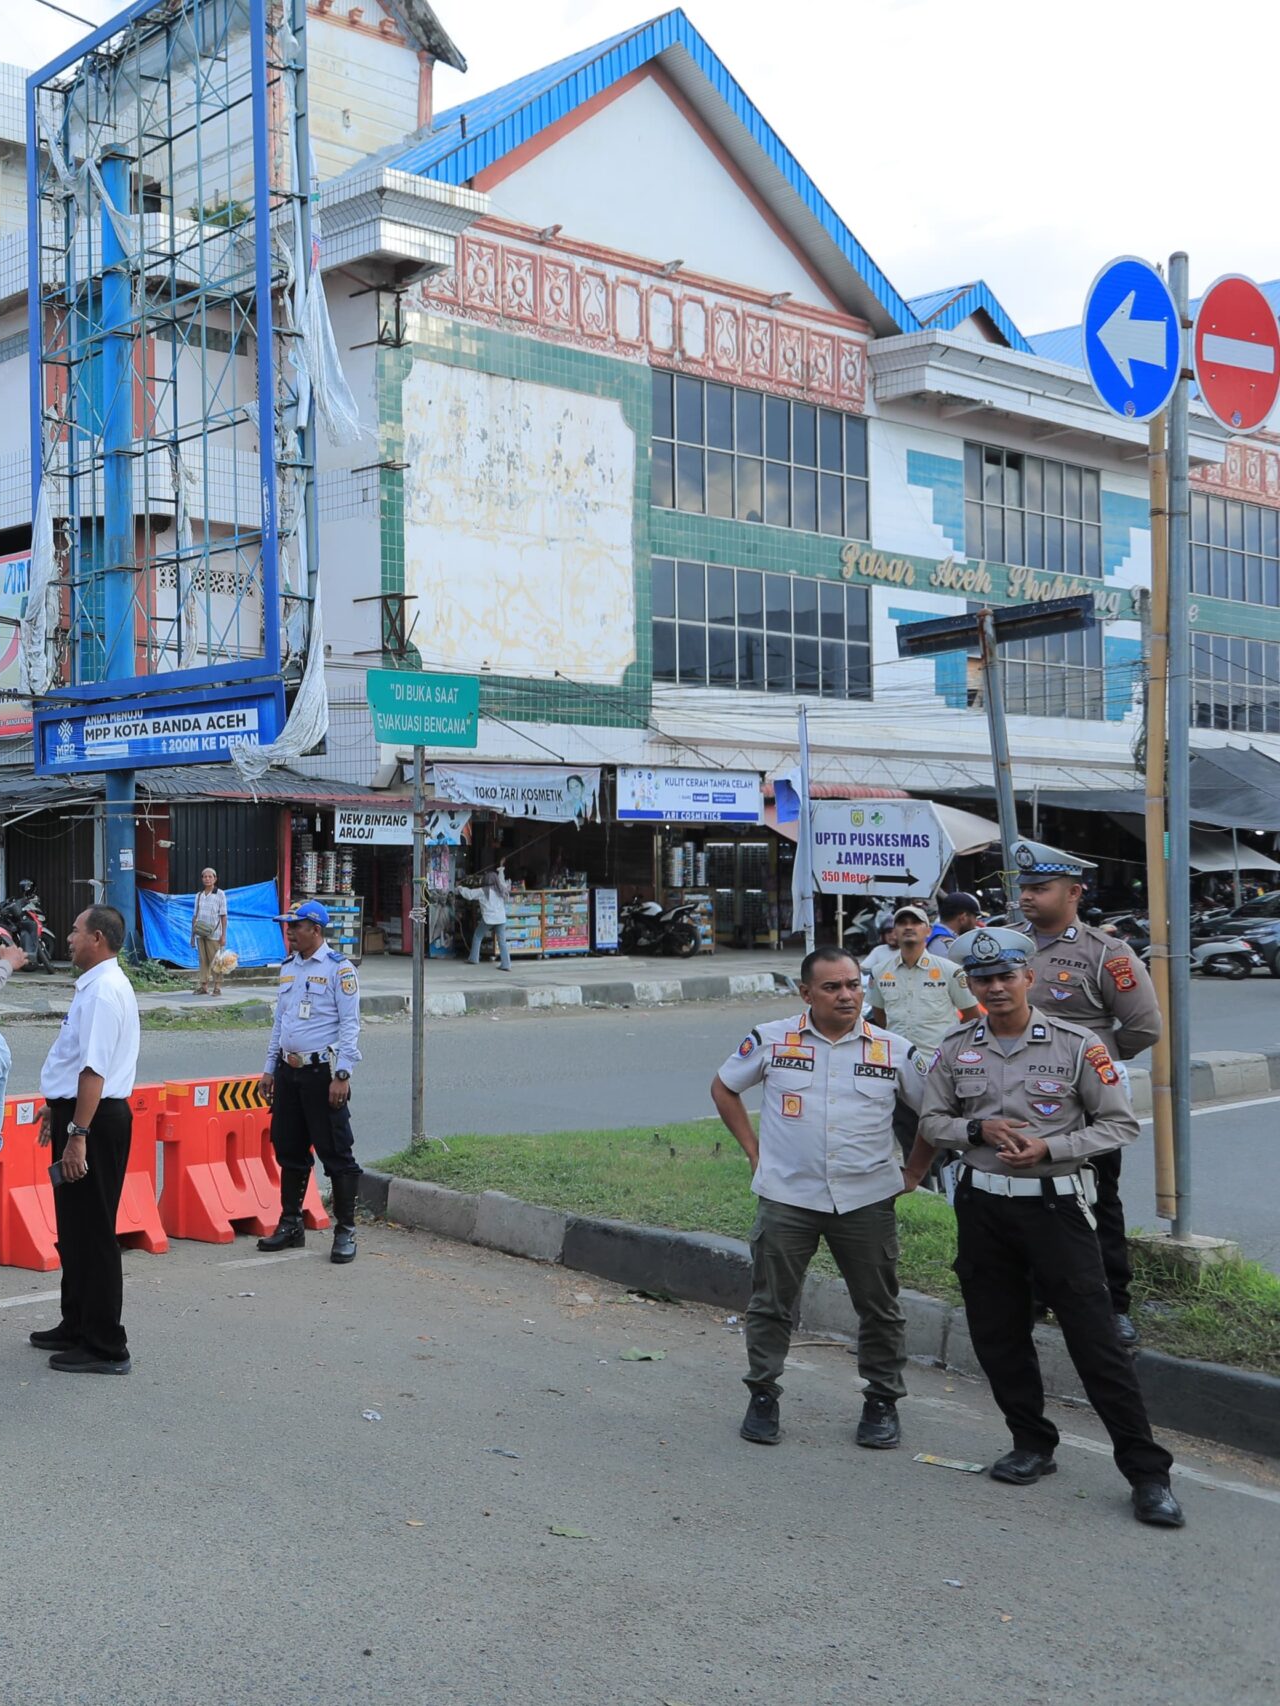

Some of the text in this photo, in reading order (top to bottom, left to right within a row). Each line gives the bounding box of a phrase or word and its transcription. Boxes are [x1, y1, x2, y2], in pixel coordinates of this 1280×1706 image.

[929, 555, 993, 594] Aceh
[406, 685, 432, 702] BUKA
[435, 687, 459, 704] SAAT
[85, 715, 107, 726] ANDA
[377, 713, 422, 731] EVAKUASI
[85, 713, 246, 742] MPP KOTA BANDA ACEH
[169, 732, 260, 752] 200M KE DEPAN
[664, 777, 753, 789] KULIT CERAH TANPA CELAH
[474, 786, 564, 802] TOKO TARI KOSMETIK
[339, 813, 408, 827] NEW BINTANG
[680, 811, 721, 820] COSMETICS
[339, 827, 374, 839] ARLOJI
[815, 832, 930, 849] UPTD PUSKESMAS
[836, 851, 905, 867] LAMPASEH
[821, 871, 870, 884] 350 Meter
[1049, 957, 1089, 970] POLRI
[775, 1058, 810, 1069] RIZAL
[857, 1066, 894, 1079] POL PP
[964, 1068, 985, 1076] REZA
[1028, 1064, 1070, 1077] POLRI
